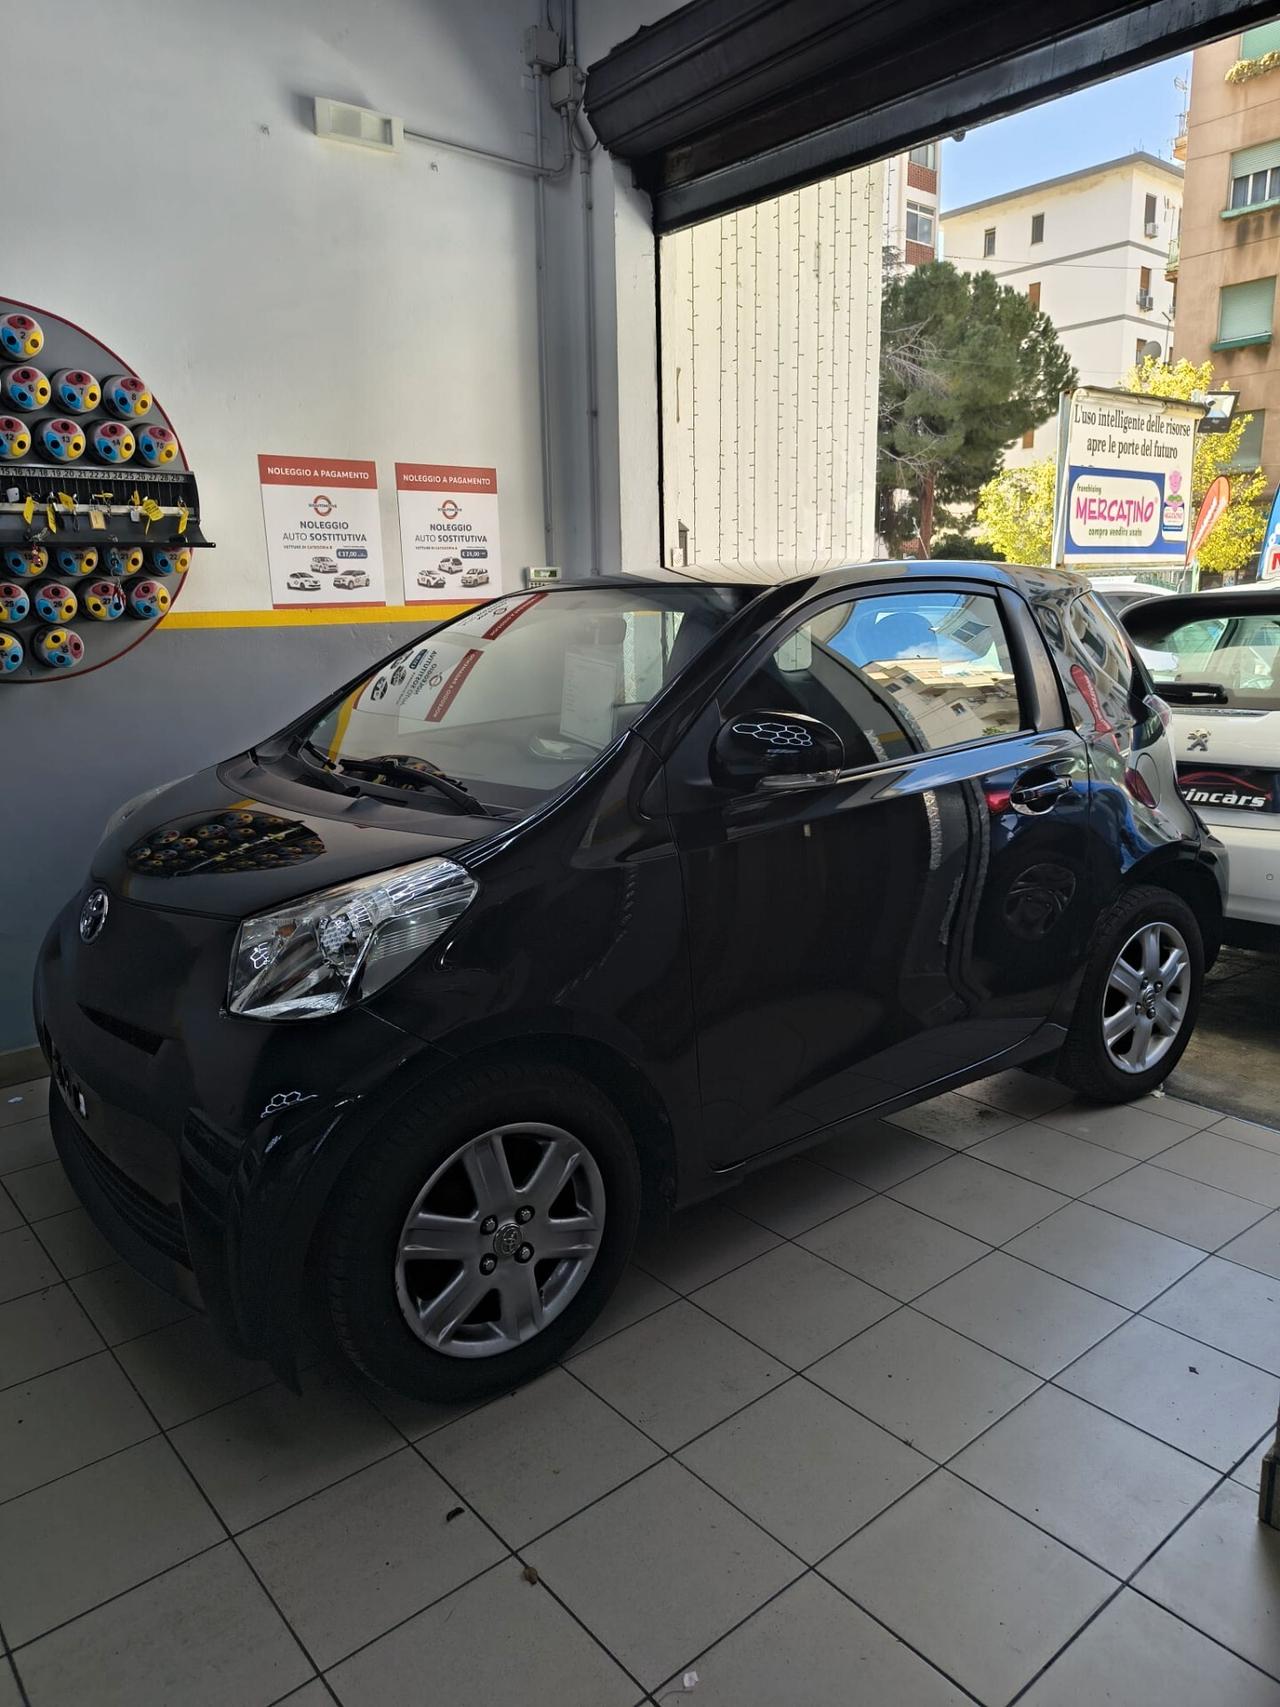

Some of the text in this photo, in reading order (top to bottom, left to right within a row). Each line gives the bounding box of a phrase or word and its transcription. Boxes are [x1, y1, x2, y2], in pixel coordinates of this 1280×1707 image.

[1074, 404, 1191, 437] L'uso intelligente delle risorse
[1087, 434, 1178, 459] apre le porte del futuro
[267, 467, 311, 477] NOLEGGIO
[320, 470, 369, 480] PAGAMENTO
[403, 474, 441, 483] NOLEGGIO
[448, 476, 491, 485] PAGAMENTO
[1076, 496, 1154, 527] MERCATINO
[300, 521, 349, 530] NOLEGGIO
[430, 524, 472, 532] NOLEGGIO
[283, 532, 367, 542] AUTO SOSTITUTIVA
[415, 534, 487, 543] AUTO SOSTITUTIVA
